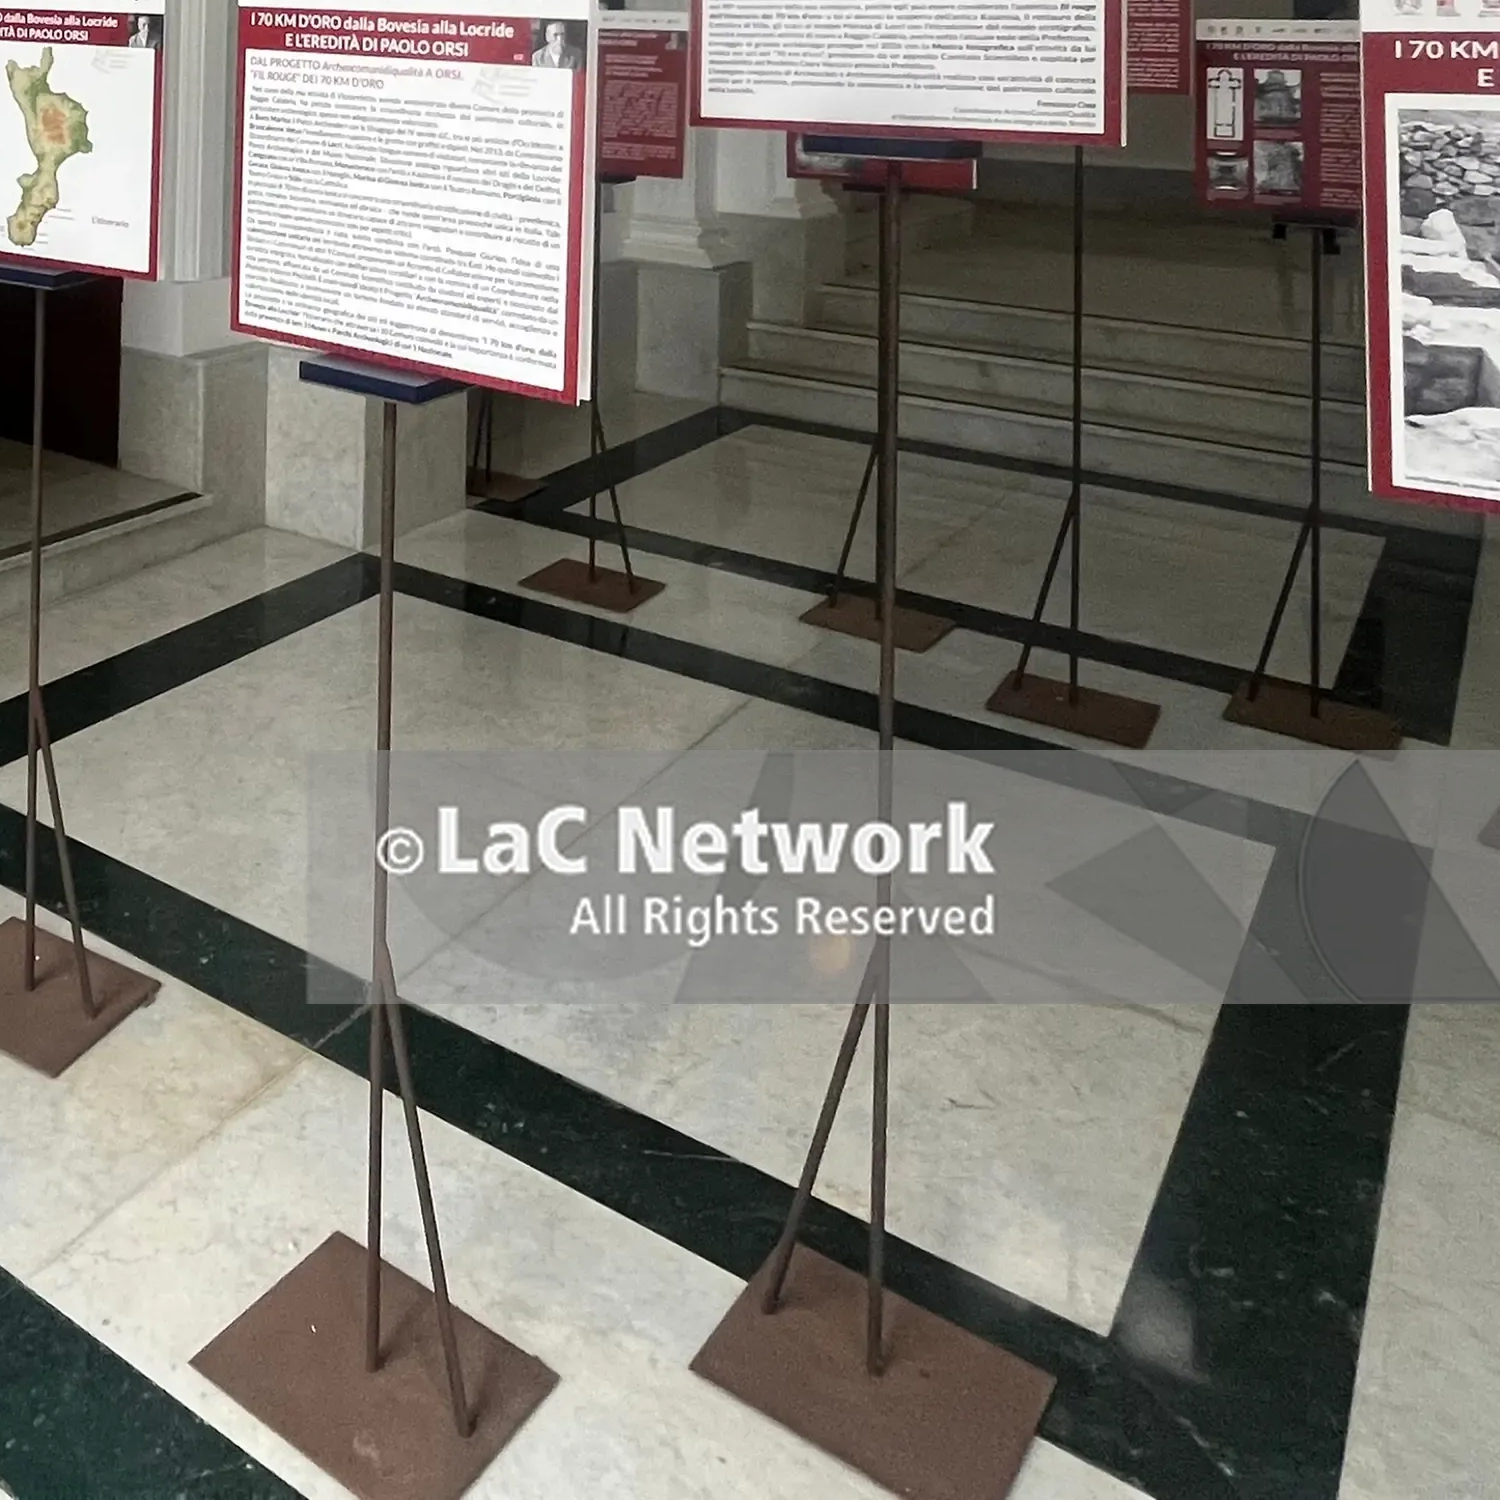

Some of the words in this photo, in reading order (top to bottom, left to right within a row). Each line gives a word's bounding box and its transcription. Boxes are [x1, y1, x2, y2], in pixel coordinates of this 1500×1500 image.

[4, 13, 25, 23] dalla
[27, 13, 62, 25] Bovesia
[64, 15, 81, 25] alla
[82, 16, 117, 27] Locride
[251, 12, 255, 25] I
[258, 13, 273, 26] 70
[275, 14, 296, 27] KM
[299, 14, 341, 29] D'ORO
[344, 16, 375, 31] dalla
[377, 18, 429, 33] Bovesia
[432, 20, 457, 35] alla
[460, 21, 514, 38] Locride
[17, 28, 27, 38] DI
[29, 28, 62, 40] PAOLO
[64, 30, 88, 41] ORSI
[286, 33, 293, 46] E
[296, 34, 360, 50] L'EREDITÀ
[363, 37, 377, 51] DI
[380, 38, 430, 54] PAOLO
[434, 41, 468, 56] ORSI
[1396, 41, 1401, 58] I
[1409, 41, 1444, 58] 70
[1451, 41, 1498, 59] KM
[251, 56, 267, 67] DAL
[270, 58, 321, 70] PROGETTO
[425, 68, 432, 77] A
[1478, 69, 1494, 86] E
